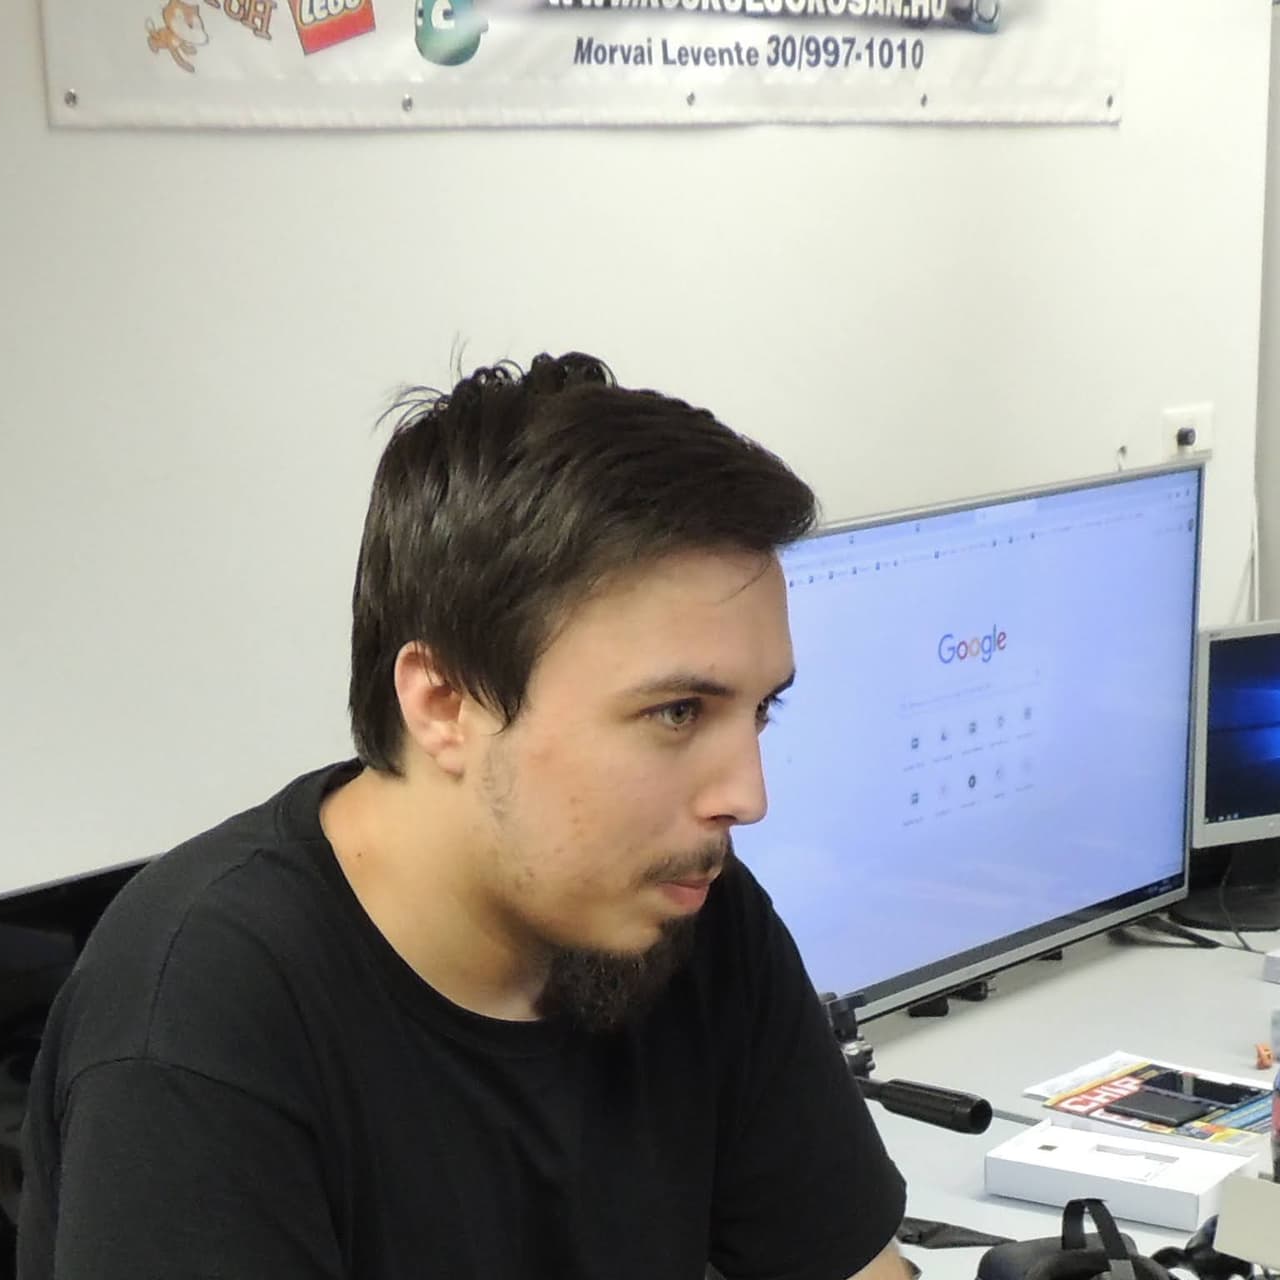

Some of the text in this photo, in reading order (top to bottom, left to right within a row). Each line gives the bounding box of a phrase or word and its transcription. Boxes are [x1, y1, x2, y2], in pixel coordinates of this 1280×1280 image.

[573, 34, 924, 70] Morvai Levente 30/997-1010
[938, 624, 1007, 664] Google
